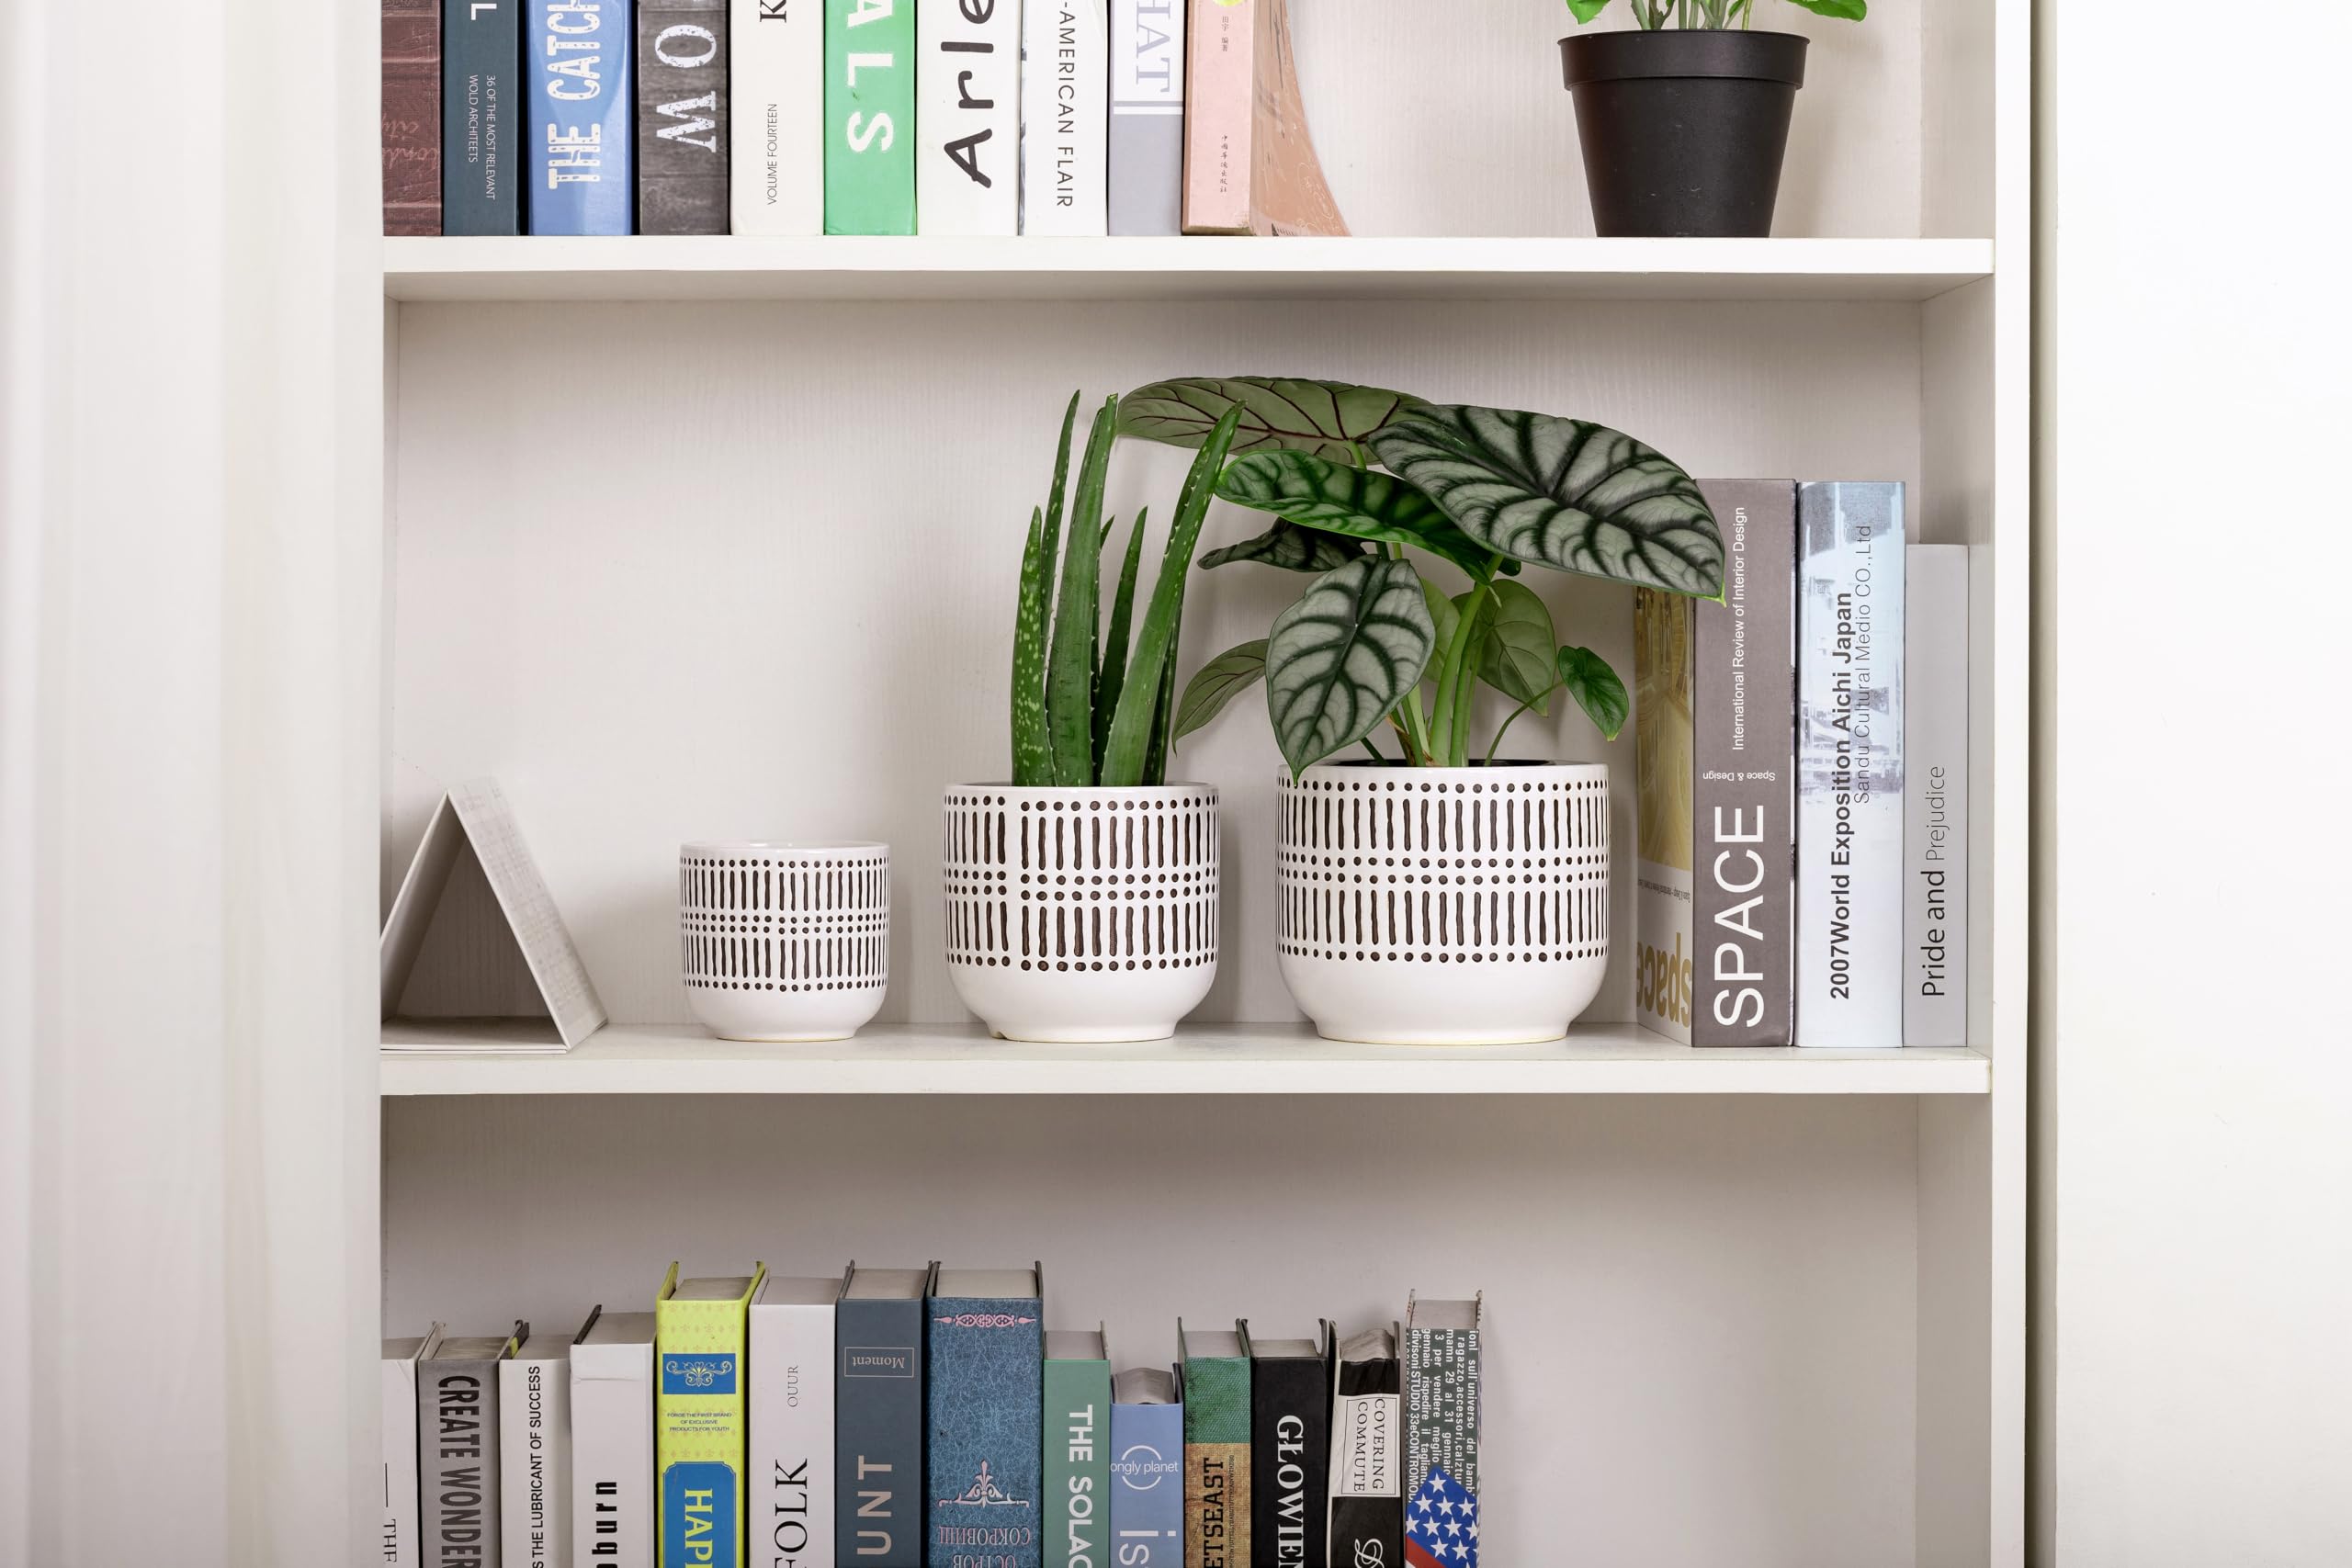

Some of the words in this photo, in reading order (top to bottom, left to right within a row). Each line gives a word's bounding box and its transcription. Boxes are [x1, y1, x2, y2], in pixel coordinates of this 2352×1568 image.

[469, 75, 478, 105] WOLD
[487, 75, 495, 86] 36
[487, 89, 495, 101] OF
[941, 0, 994, 188] Arle
[469, 107, 478, 162] ARCHITEETS
[487, 104, 495, 121] THE
[767, 105, 777, 151] FOURTEEN
[487, 124, 495, 151] MOST
[548, 122, 601, 189] THE
[486, 154, 495, 199] RELEVANT
[767, 154, 776, 205] VOLUME
[1057, 147, 1073, 206] FLAIR
[1733, 507, 1747, 551] Design
[1733, 556, 1744, 599] Interior
[1733, 604, 1744, 616] of
[1832, 592, 1856, 664] Japan
[1854, 604, 1871, 661] Medio
[1733, 621, 1744, 667] Review
[1733, 672, 1744, 750] International
[1832, 672, 1851, 733] Aichi
[1854, 668, 1871, 739] Cultural
[1703, 771, 1734, 781] Design
[1737, 773, 1744, 781] &
[1747, 771, 1775, 781] Space
[1854, 741, 1871, 804] Sandu
[1831, 741, 1855, 866] Exposition
[1926, 767, 1950, 860] Prejudice
[1713, 806, 1764, 1027] SPACE
[1921, 871, 1944, 919] and
[1830, 875, 1849, 998] 2007World
[1921, 930, 1944, 995] Pride
[853, 1357, 904, 1368] Moment
[1411, 1329, 1421, 1369] divisoni
[1422, 1328, 1432, 1369] gennaio
[1432, 1348, 1442, 1368] per
[529, 1367, 541, 1427] SUCCESS
[788, 1367, 797, 1407] OUUR
[1410, 1371, 1420, 1411] STUDIO
[1419, 1376, 1432, 1421] rispedire
[1433, 1375, 1443, 1419] vendere
[1445, 1371, 1454, 1384] 29
[1445, 1393, 1454, 1402] al
[438, 1376, 480, 1458] CREATE
[1069, 1404, 1092, 1461] THE
[1444, 1410, 1453, 1423] 31
[530, 1432, 541, 1449] OF
[1353, 1401, 1368, 1493] COMMUTE
[1373, 1397, 1385, 1489] COVERING
[1430, 1427, 1442, 1463] meglio
[1466, 1438, 1476, 1454] del
[1110, 1460, 1141, 1475] ongly
[1144, 1459, 1178, 1474] planet
[1465, 1462, 1475, 1496] bamb
[531, 1453, 543, 1528] LUBRICANT
[857, 1455, 892, 1554] UNT
[532, 1532, 543, 1558] THE
